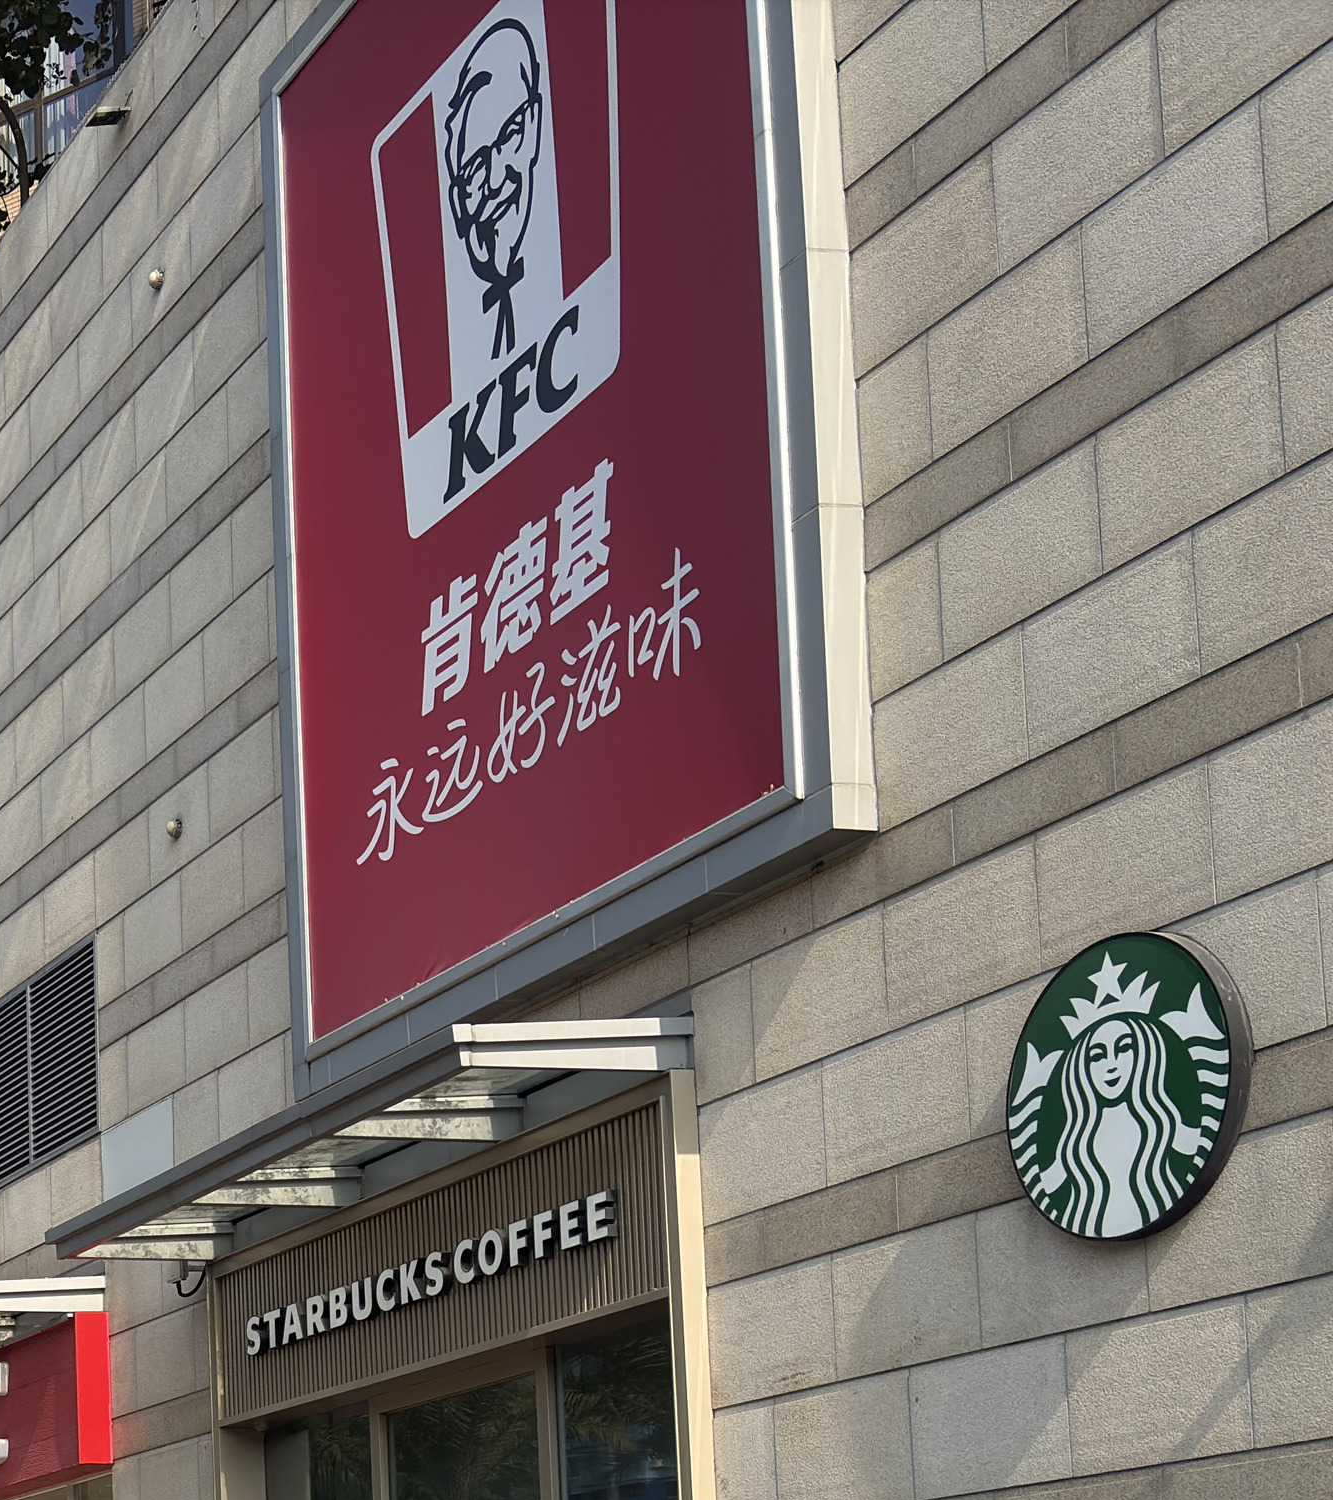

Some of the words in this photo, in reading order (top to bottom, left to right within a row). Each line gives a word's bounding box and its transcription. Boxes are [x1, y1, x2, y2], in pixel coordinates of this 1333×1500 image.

[444, 306, 580, 505] KFC
[421, 458, 614, 716] 肯德基
[357, 548, 701, 866] 永远好滋味
[246, 1250, 450, 1357] STARBUCKS
[453, 1190, 617, 1285] COFFEE
